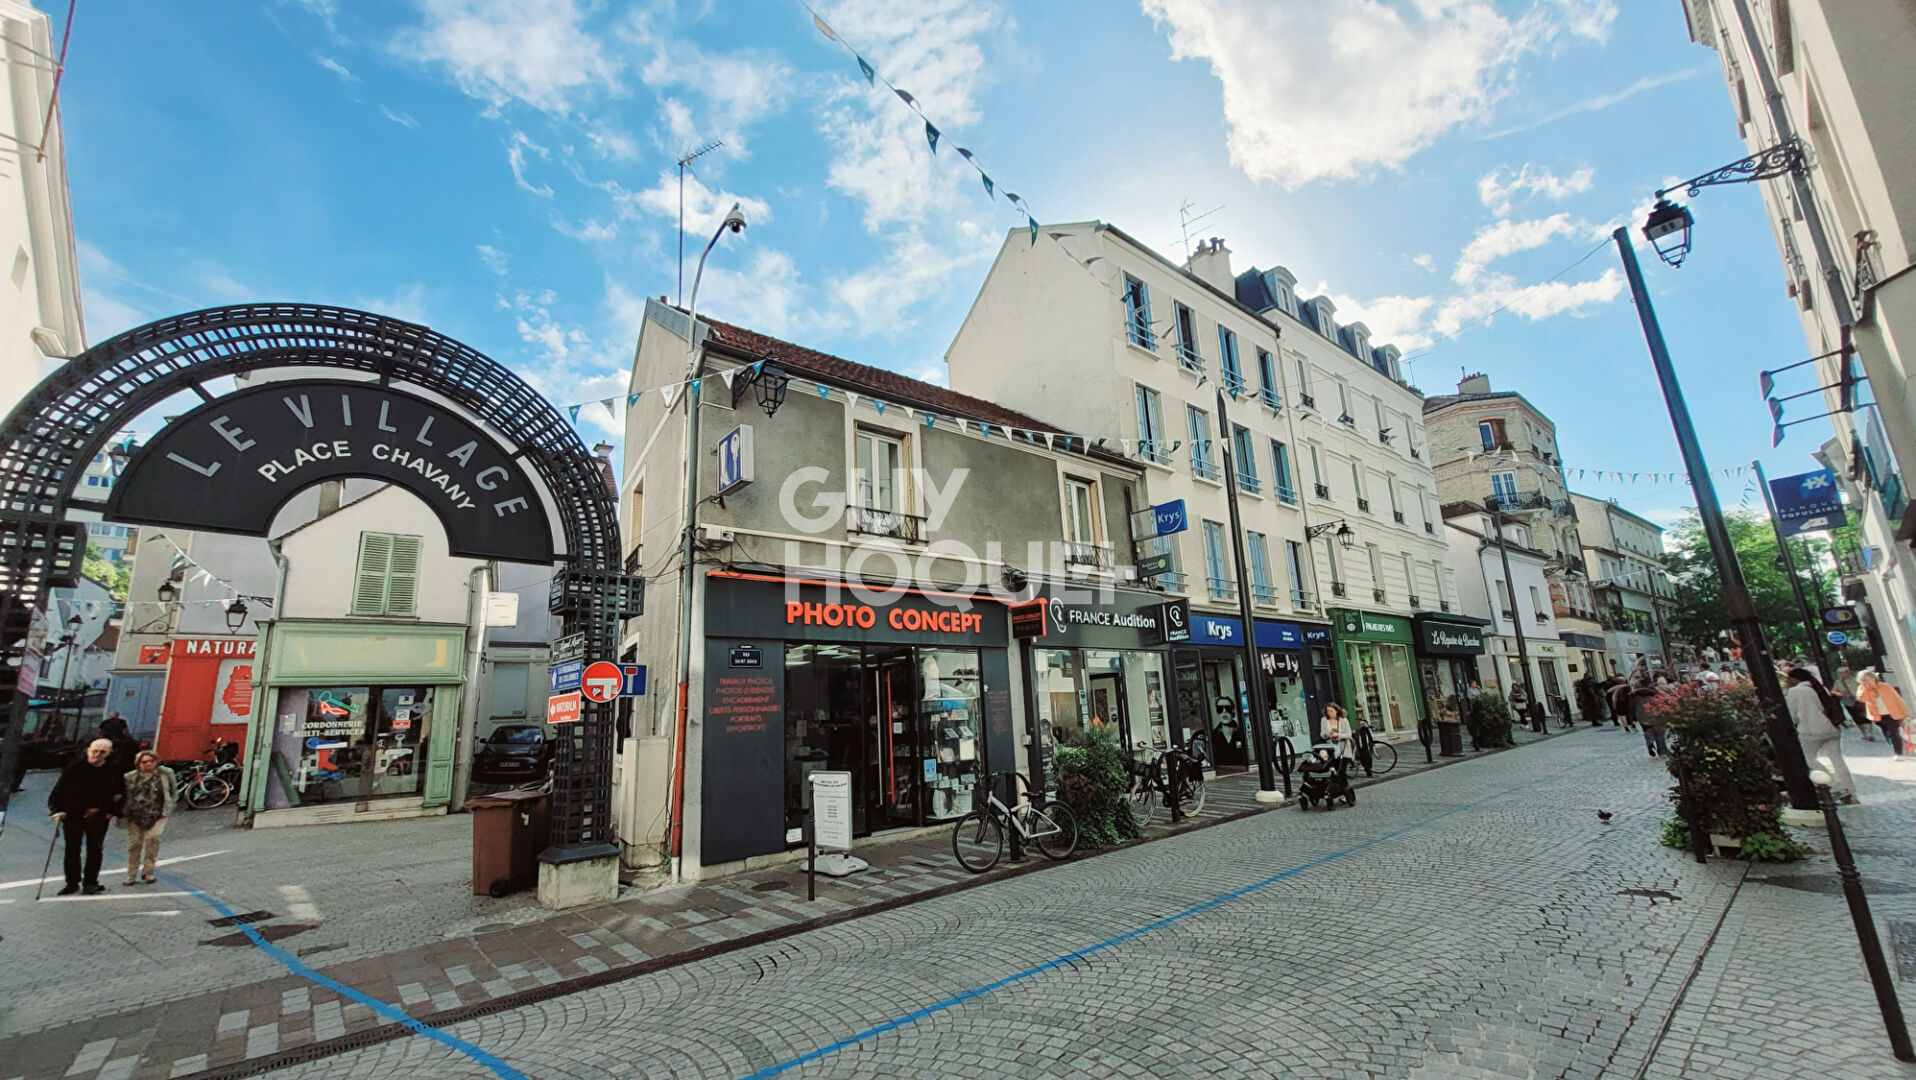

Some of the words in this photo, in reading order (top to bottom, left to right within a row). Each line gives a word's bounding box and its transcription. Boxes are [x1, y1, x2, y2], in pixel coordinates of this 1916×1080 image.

[166, 416, 256, 477] LE
[283, 394, 528, 518] VILLAGE
[257, 440, 352, 483] PLACE
[372, 443, 475, 512] CHAVANY
[1157, 511, 1180, 524] Krys
[1781, 504, 1838, 519] POPULAIRE
[787, 601, 876, 628] PHOTO
[889, 608, 982, 633] CONCEPT
[1069, 609, 1110, 626] FRANCE
[1112, 611, 1156, 629] Audition
[1207, 621, 1233, 640] Krys
[1307, 631, 1326, 640] Krys
[293, 728, 365, 738] MULTI-SERVICES
[303, 720, 363, 730] CORDONNERIE
